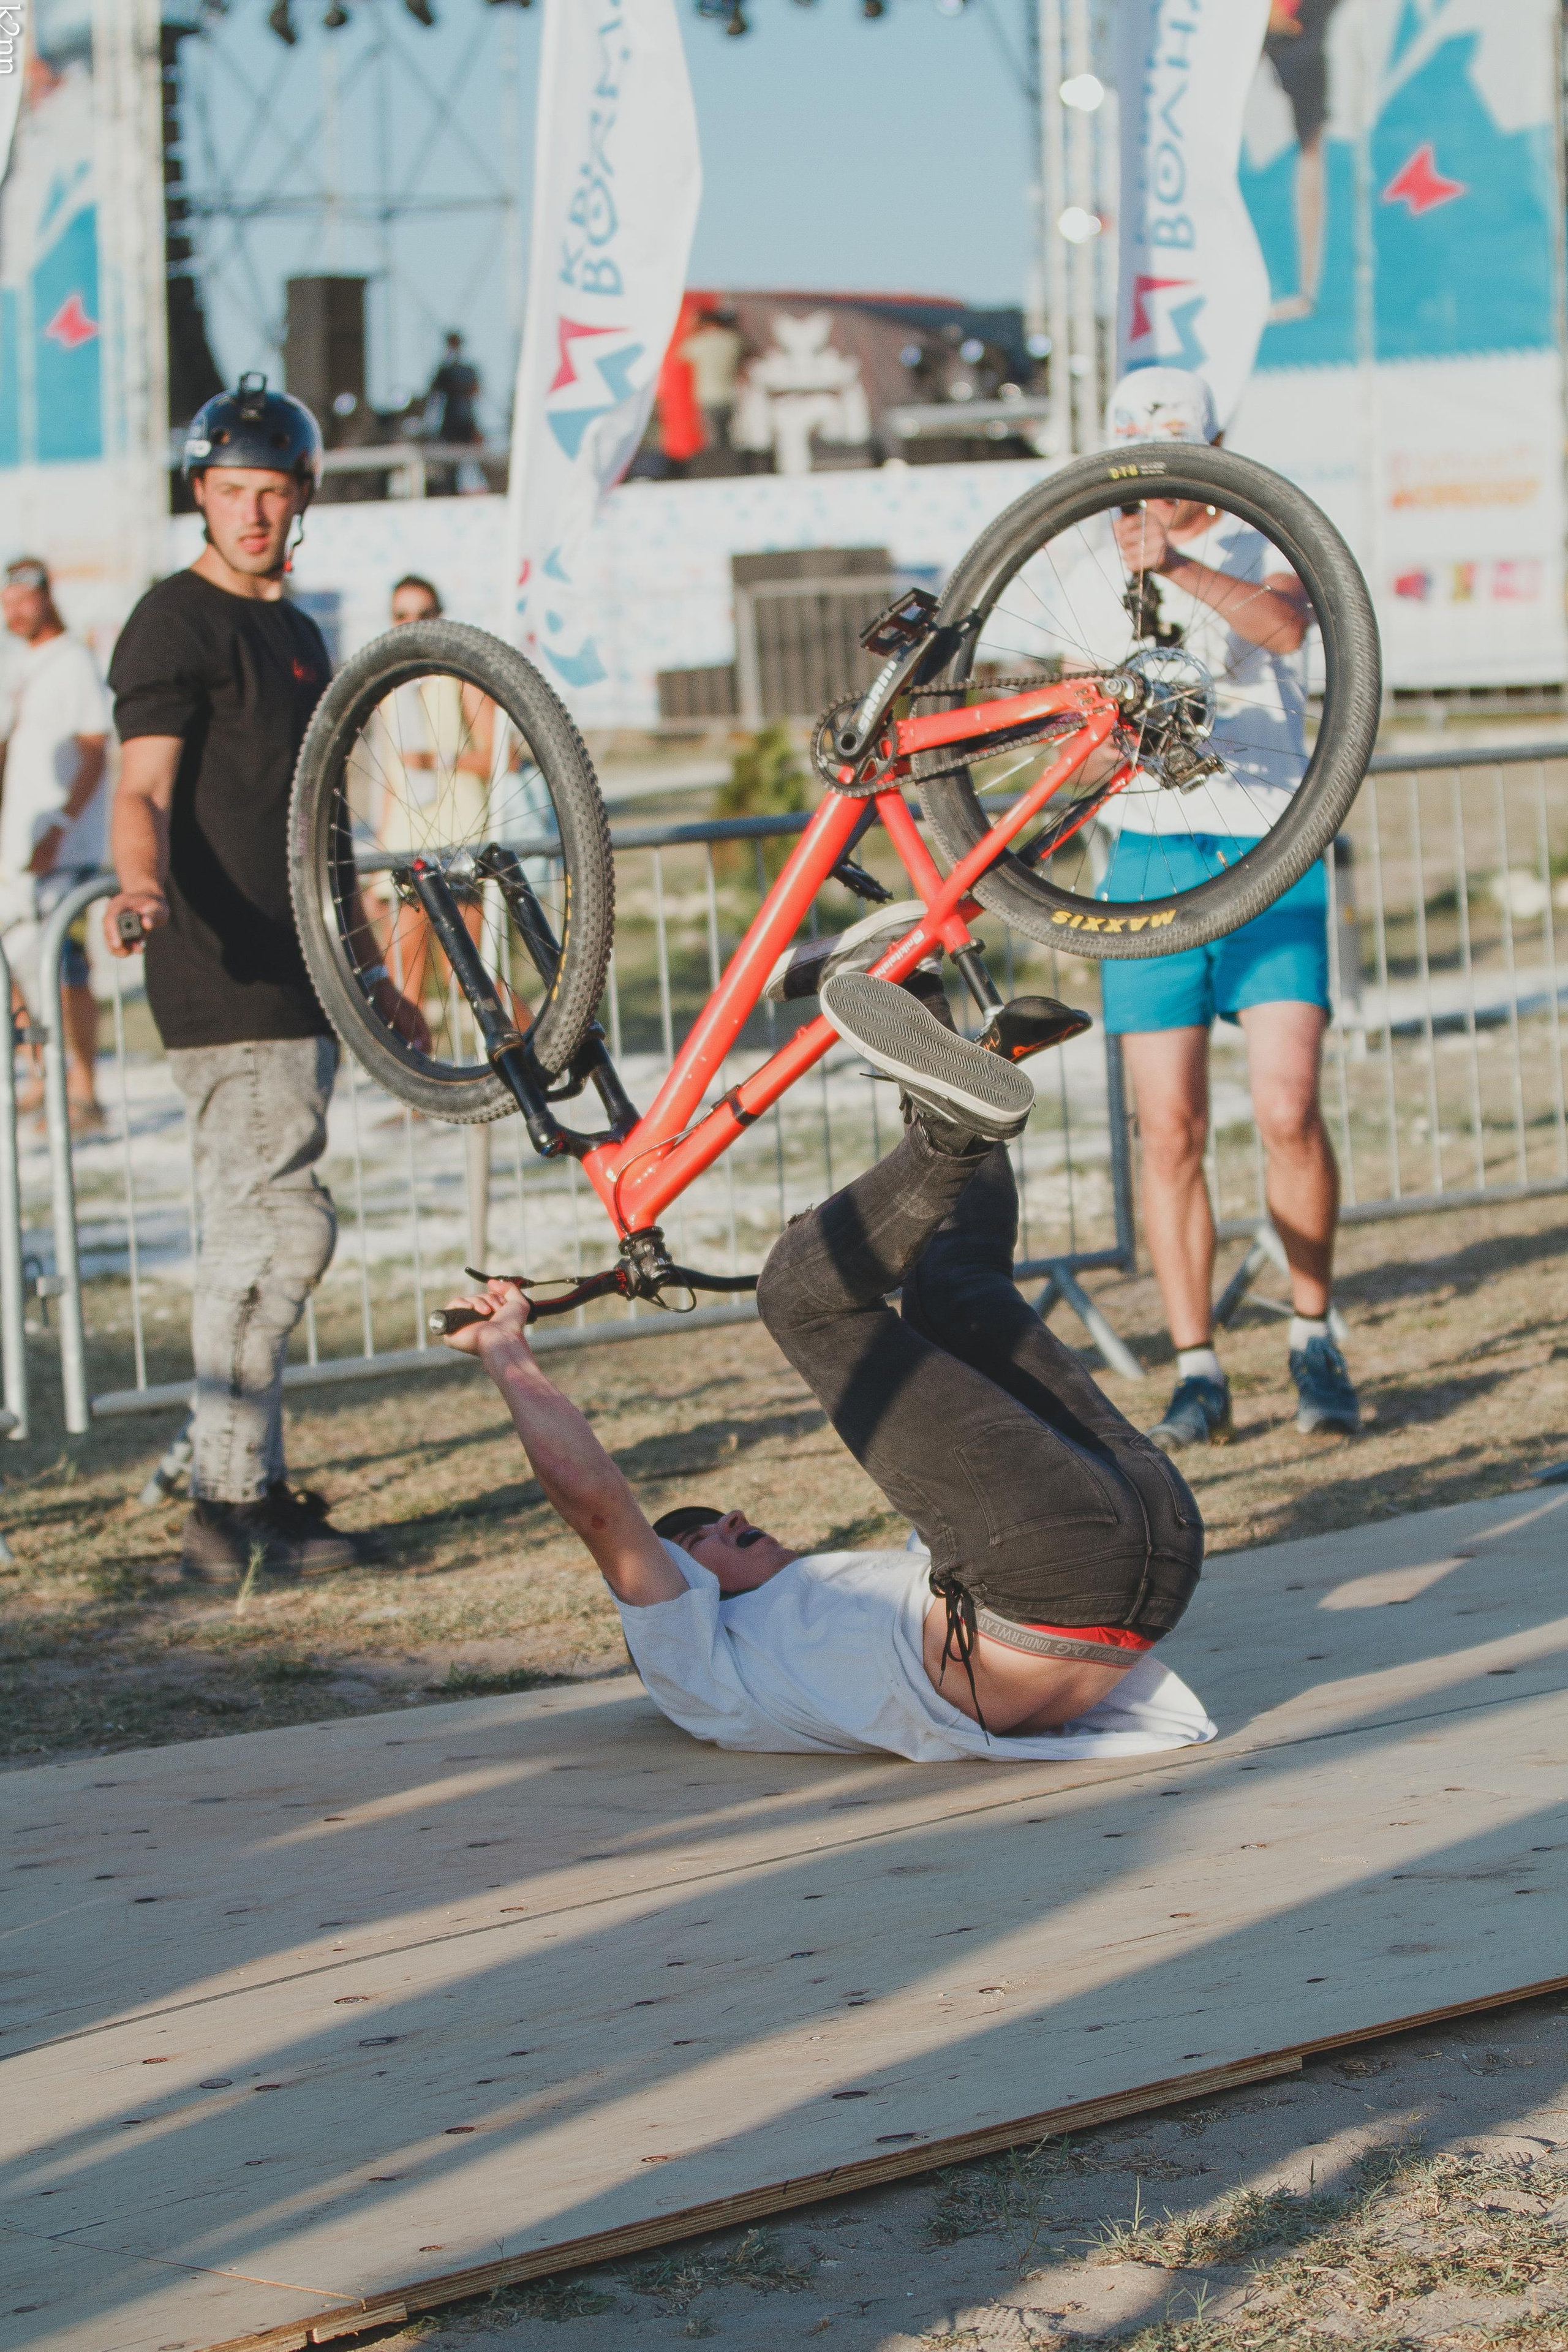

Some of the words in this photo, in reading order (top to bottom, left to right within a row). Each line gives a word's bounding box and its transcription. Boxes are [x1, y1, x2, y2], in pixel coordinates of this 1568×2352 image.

[858, 660, 897, 735] SRAM
[1052, 910, 1177, 933] MAXXIS
[980, 1615, 1052, 1651] UNDERWEAR
[1054, 1642, 1090, 1657] D&G
